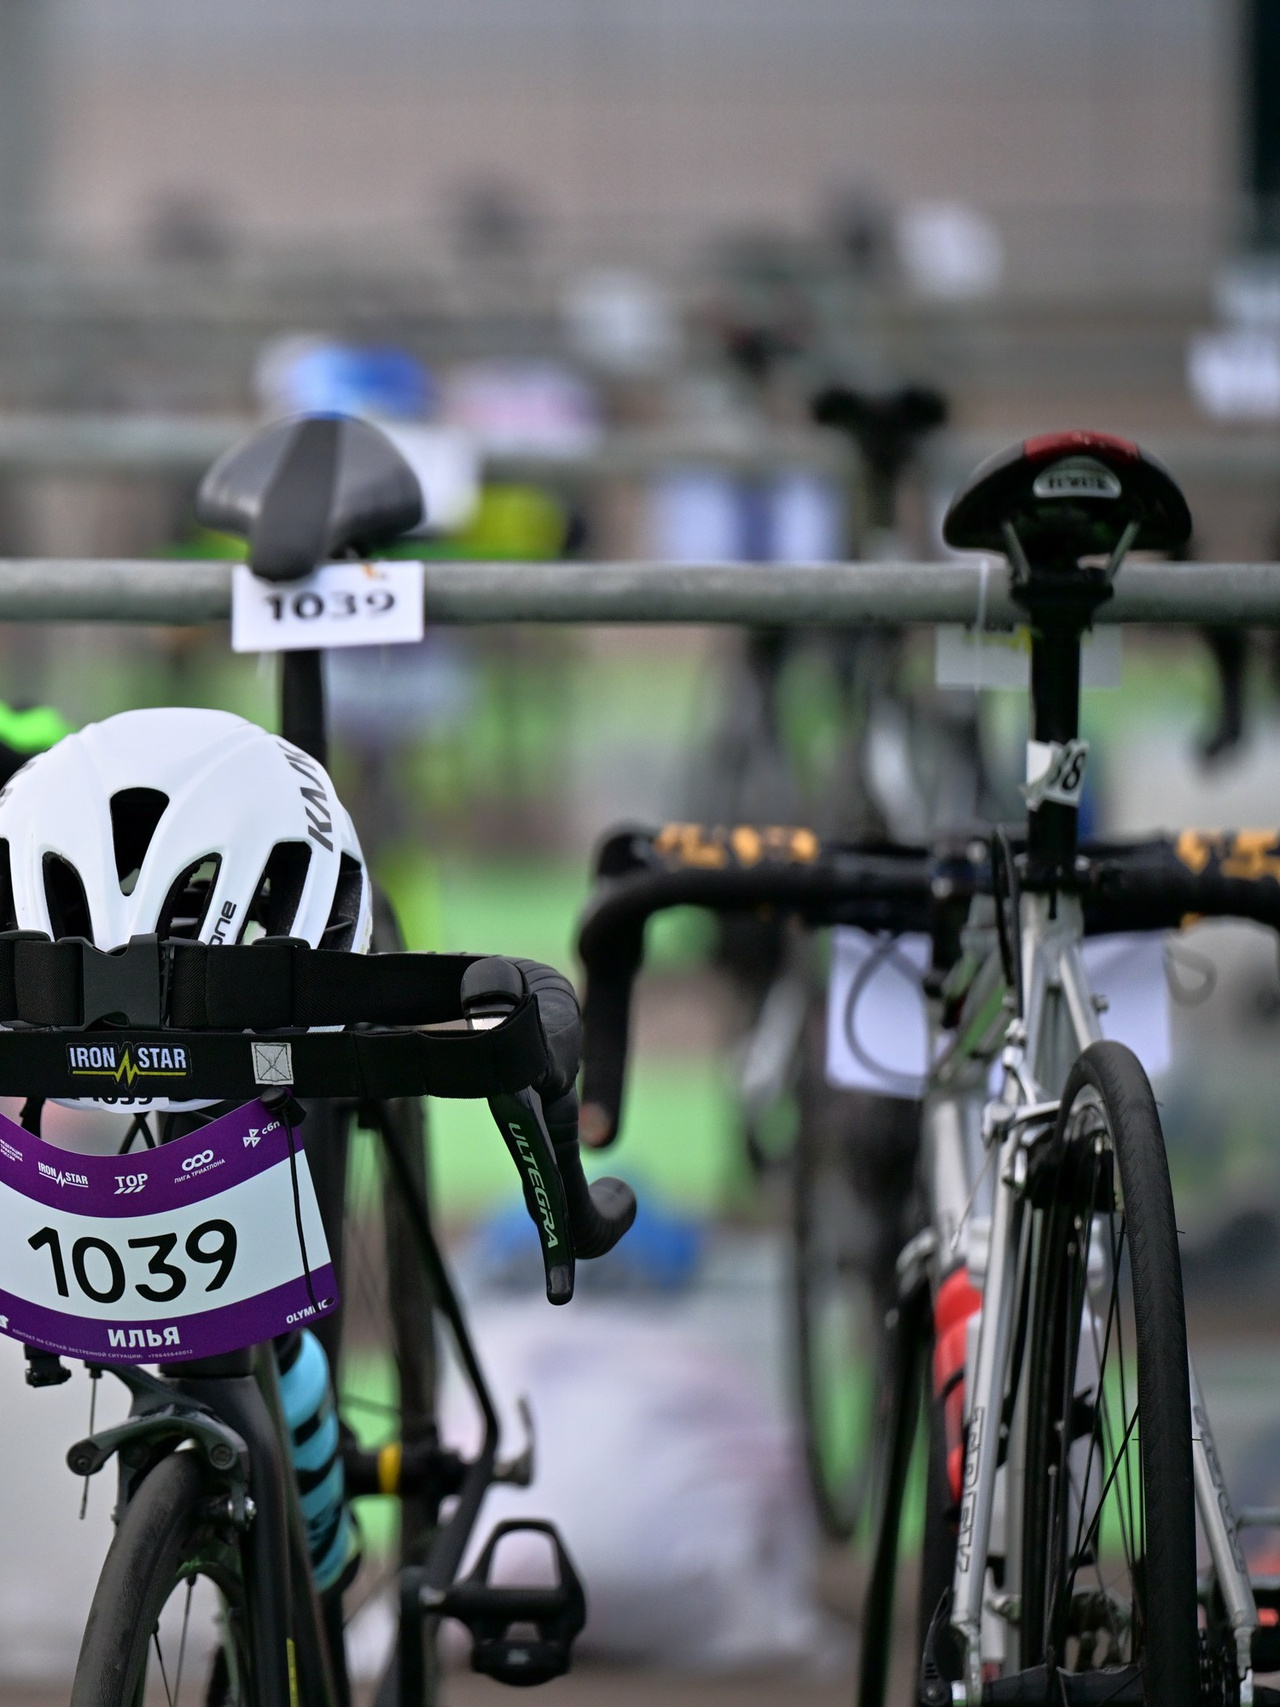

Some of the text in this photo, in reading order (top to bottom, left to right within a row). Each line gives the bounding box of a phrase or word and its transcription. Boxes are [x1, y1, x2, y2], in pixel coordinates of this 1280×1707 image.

[265, 589, 396, 621] 1039
[69, 1047, 187, 1069] IRON STAR
[37, 1161, 89, 1185] IRON STAR
[174, 1158, 226, 1184] ЛИГА ТРИАТЛОНА
[508, 1122, 559, 1249] ULTEGRA
[27, 1218, 238, 1304] 1039
[285, 1299, 329, 1324] OLYMIC
[107, 1326, 181, 1348] ИЛЬЯ
